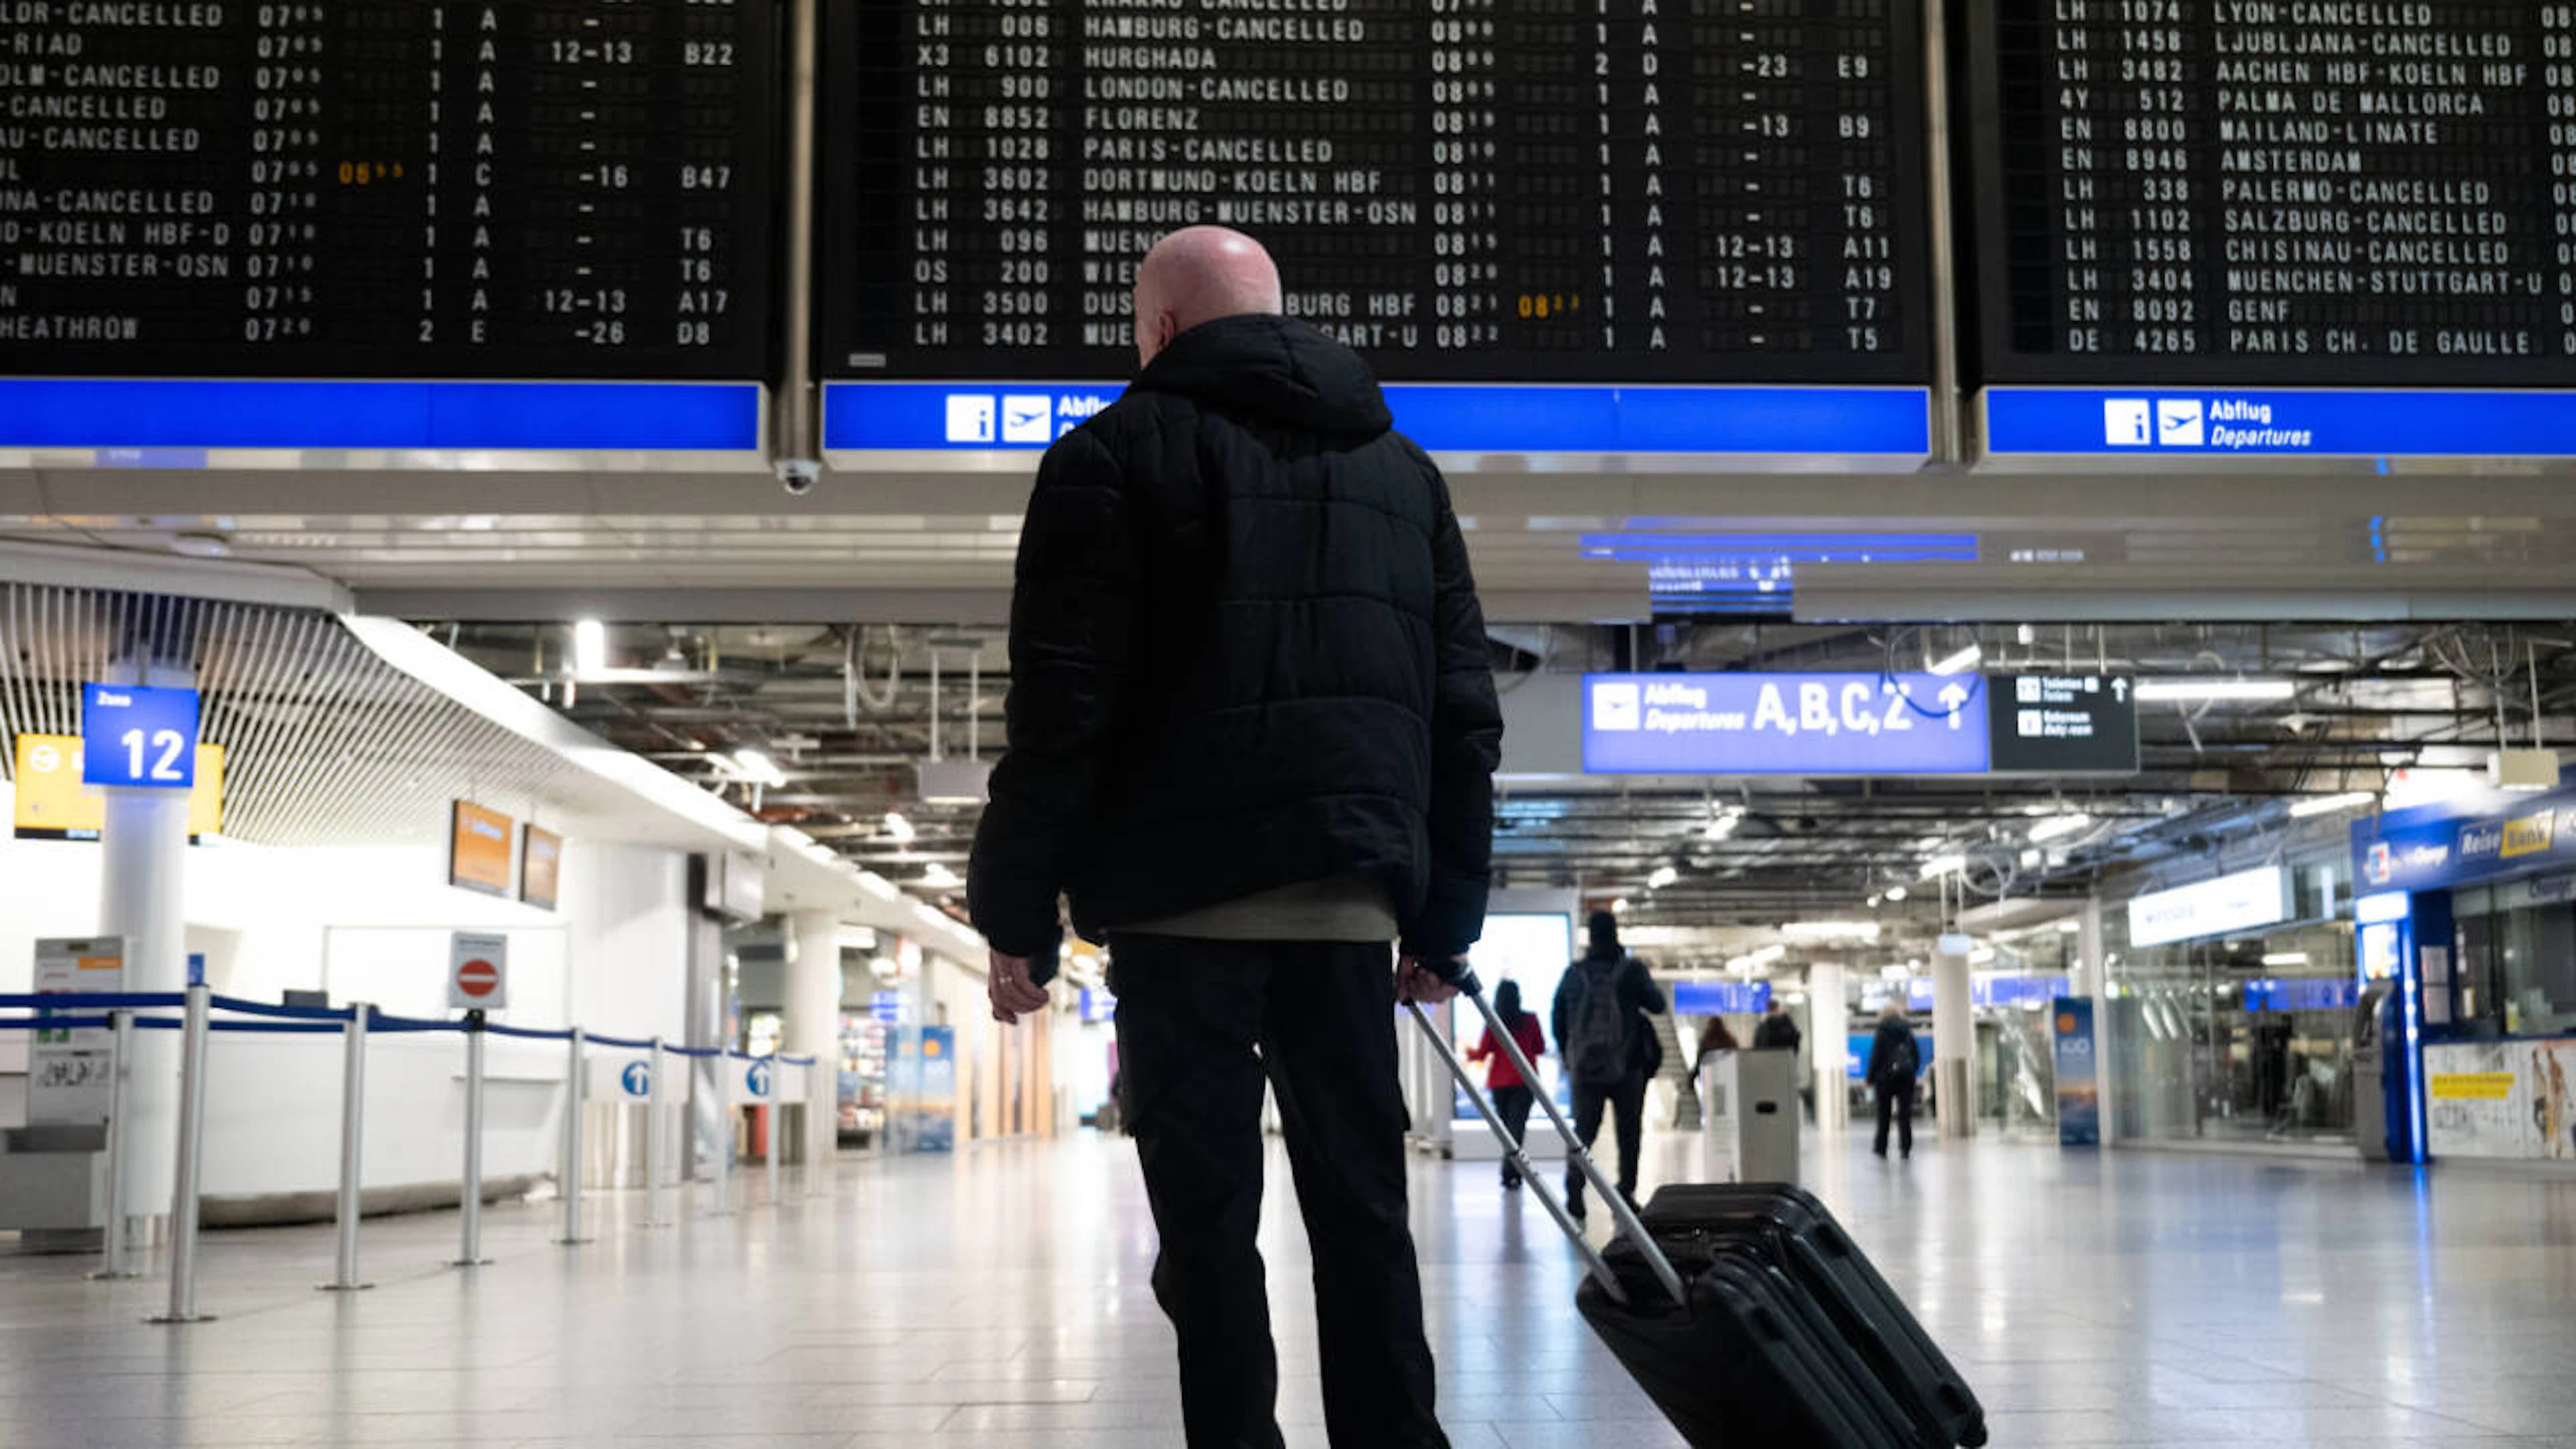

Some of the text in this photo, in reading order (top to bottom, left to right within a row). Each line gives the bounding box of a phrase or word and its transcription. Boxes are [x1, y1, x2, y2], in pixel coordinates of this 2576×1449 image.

[481, 9, 496, 30] A
[2056, 0, 2086, 20] LH
[2122, 0, 2180, 21] 1074
[2214, 1, 2431, 25] LYON-CANCELLED
[918, 15, 949, 36] LH
[1085, 16, 1364, 41] HAMBURG-CANCELLED
[685, 42, 733, 65] B22
[2057, 29, 2086, 50] LH
[2123, 30, 2180, 52] 1458
[2216, 32, 2510, 56] LJUBLJANA-CANCELLED
[918, 44, 949, 66] X3
[985, 46, 1048, 67] 6102
[1085, 46, 1216, 69] HURGHADA
[1595, 52, 1609, 74] 2
[1838, 56, 1868, 78] E9
[2058, 59, 2088, 80] LH
[2123, 59, 2182, 81] 3482
[2217, 60, 2310, 83] AACHEN
[2327, 62, 2465, 85] HBF-KOELN
[2483, 64, 2526, 85] HBF
[918, 76, 949, 97] LH
[1002, 76, 1049, 98] 900
[1085, 76, 1348, 101] LONDON-CANCELLED
[1645, 83, 1659, 104] A
[2060, 88, 2088, 109] 4Y
[2141, 89, 2183, 111] 512
[2218, 90, 2296, 112] PALMA
[2312, 91, 2341, 113] DE
[2360, 92, 2483, 115] MALLORCA
[918, 106, 949, 127] EN
[985, 107, 1048, 129] 8852
[1086, 107, 1198, 129] FLORENZ
[1839, 115, 1869, 138] B9
[2061, 117, 2436, 144] EN 8800 MAILAND-LINATE
[918, 138, 1332, 162] LH 1028 PARIS-CANCELLED
[2062, 148, 2361, 172] EN 8946 AMSTERDAM
[476, 163, 490, 185] C
[682, 166, 729, 188] B47
[918, 168, 1871, 198] LH 3602 DORTMUND-KOELN HBF T6
[2064, 178, 2488, 204] LH 338 PALERMO-CANCELLED
[475, 195, 489, 215] A
[918, 199, 1873, 228] LH 3642 HAMBURG-MUENSTER-OSN T6
[2066, 209, 2506, 234] LH 1102 SALZBURG-CANCELLED
[683, 228, 711, 250] T6
[917, 230, 947, 250] LH
[1002, 229, 1047, 252] 096
[1648, 235, 1662, 256] A
[1844, 236, 1888, 258] A11
[2066, 238, 2508, 264] LH 1558 CHISINAU-CANCELLED
[682, 259, 710, 282] T6
[916, 260, 947, 282] OS
[1002, 261, 1047, 283] 200
[1845, 267, 1891, 289] A19
[2068, 268, 2541, 294] LH 3404 MUENCHEN-STUTTGART-U
[680, 290, 727, 312] A17
[916, 291, 947, 313] LH
[984, 291, 1047, 314] 3500
[1369, 294, 1414, 316] HBF
[1847, 297, 1875, 319] T7
[2070, 298, 2288, 322] EN 8092 GENF
[420, 320, 433, 341] 2
[472, 321, 484, 341] E
[678, 322, 709, 345] D8
[916, 323, 947, 344] LH
[984, 323, 1047, 345] 3402
[1848, 327, 1878, 350] T5
[2070, 329, 2528, 354] DE 4265 PARIS CH. DE GAULLE
[2210, 399, 2271, 424] Abflug
[2211, 425, 2312, 449] Departures
[121, 728, 184, 780] 12
